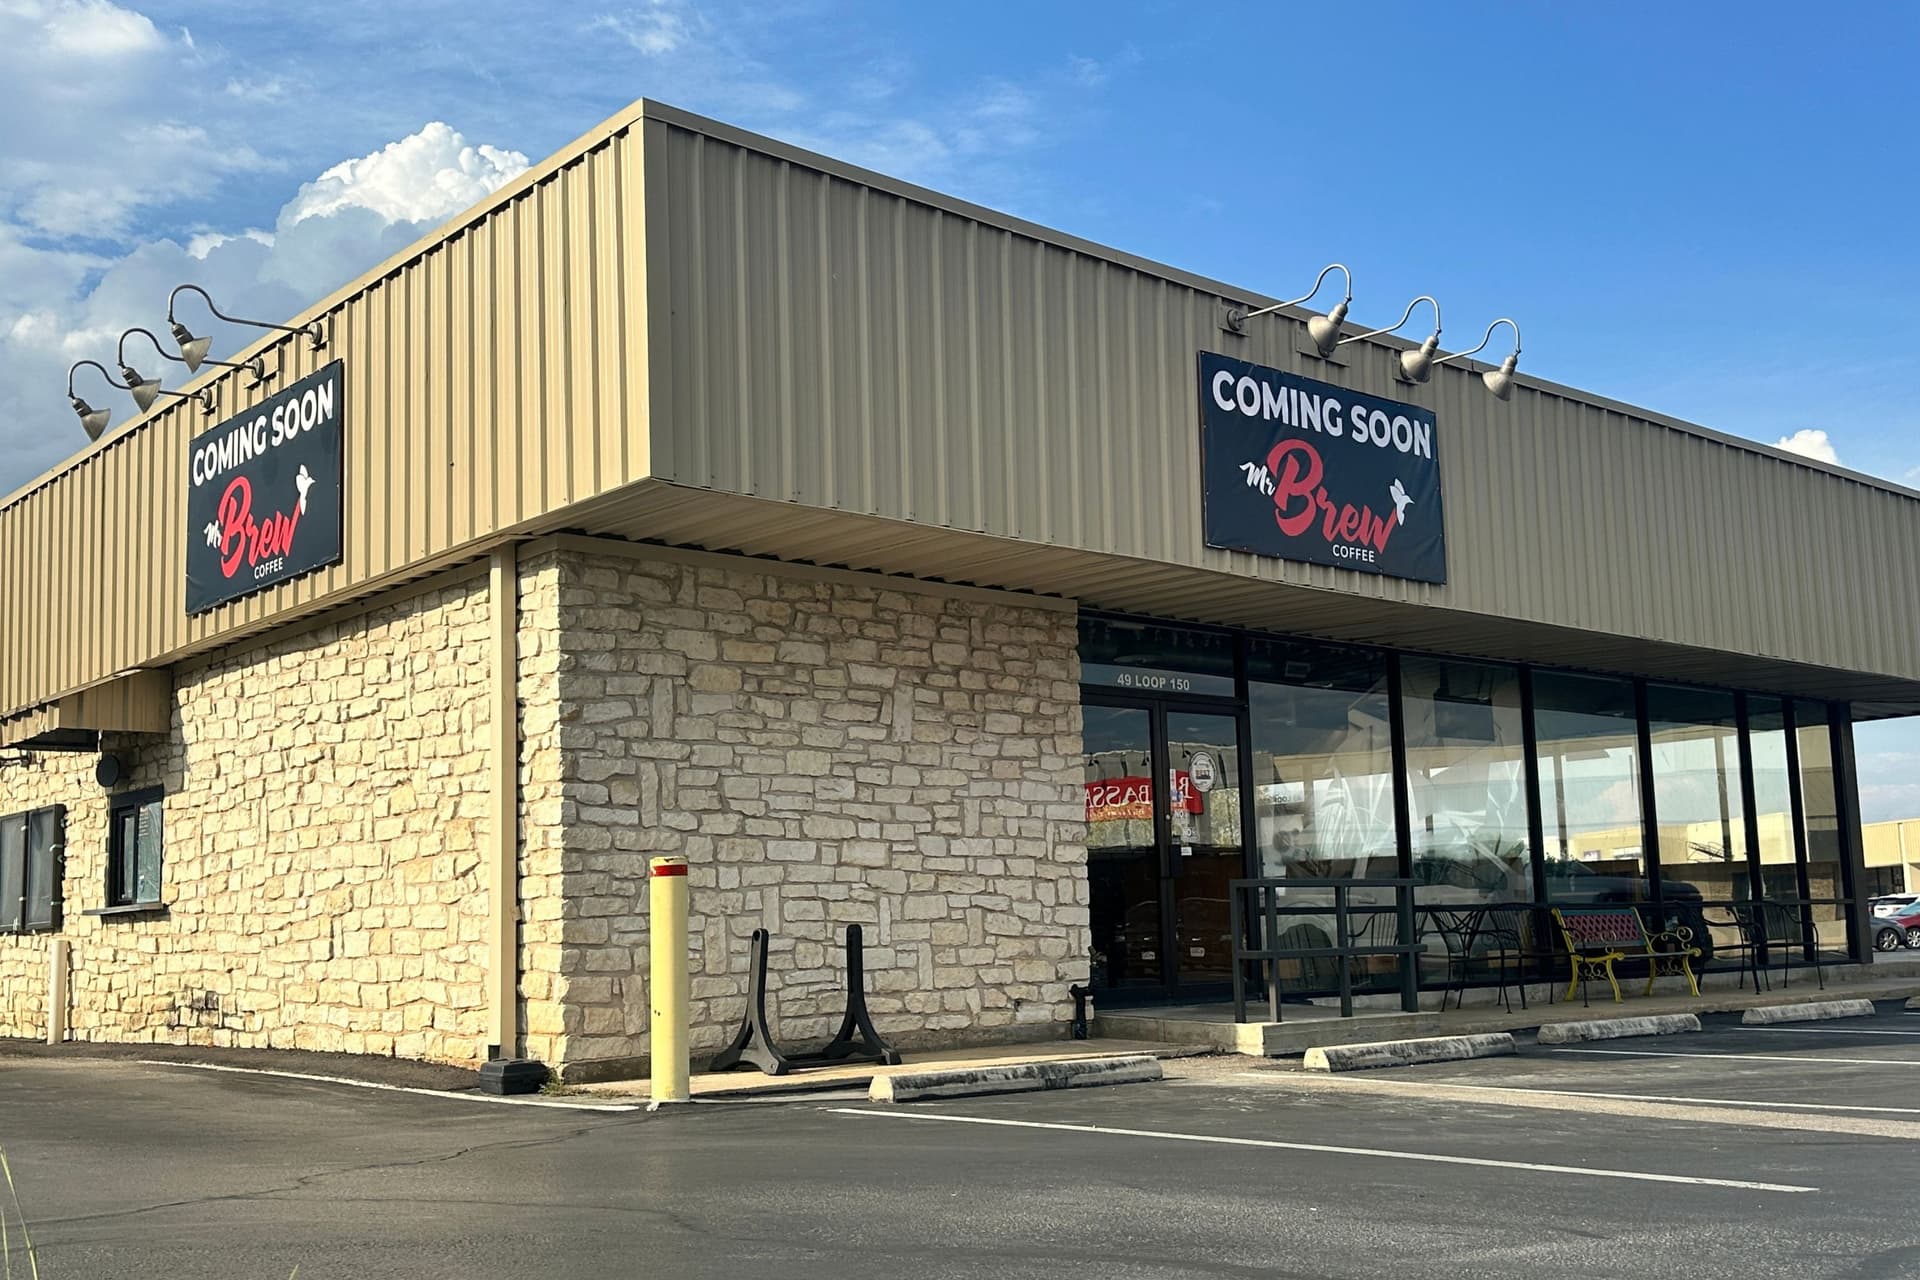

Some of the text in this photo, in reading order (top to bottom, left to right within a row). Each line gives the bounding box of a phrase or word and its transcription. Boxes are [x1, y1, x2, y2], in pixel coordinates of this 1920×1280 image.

[193, 378, 334, 487] COMING SOON
[1212, 370, 1432, 459] COMING SOON
[203, 475, 302, 579] Mr Brew
[1239, 438, 1398, 555] Mr Brew
[254, 556, 283, 580] COFFEE
[1332, 544, 1375, 563] COFFEE
[1117, 674, 1190, 691] 49 LOOP 150
